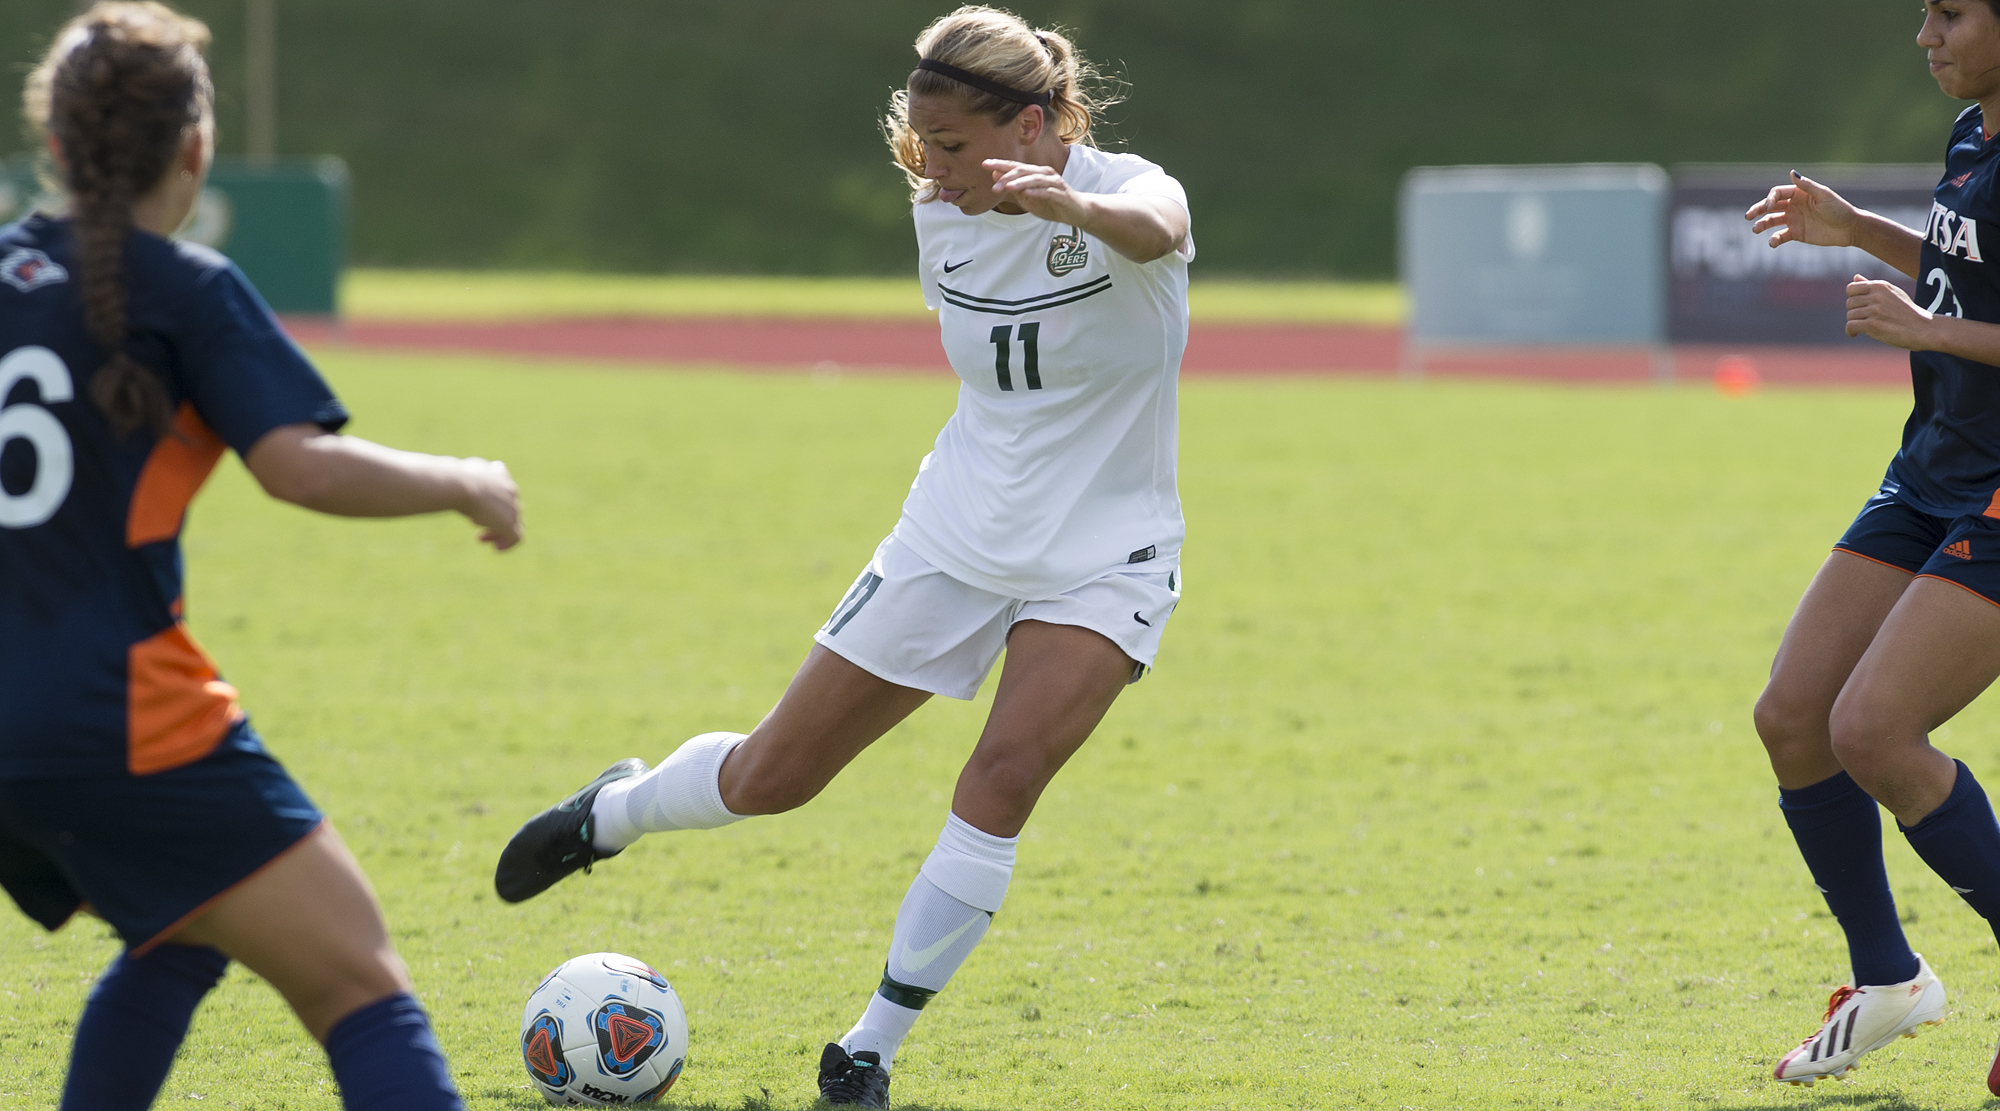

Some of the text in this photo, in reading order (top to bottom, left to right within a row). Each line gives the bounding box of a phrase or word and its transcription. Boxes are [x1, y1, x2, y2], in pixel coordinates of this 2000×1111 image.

[1051, 252, 1087, 266] 49ERS
[989, 321, 1043, 392] 11
[0, 344, 75, 530] 6
[1942, 547, 1973, 561] adidas
[822, 571, 884, 637] 11
[582, 1083, 630, 1104] NCAA
